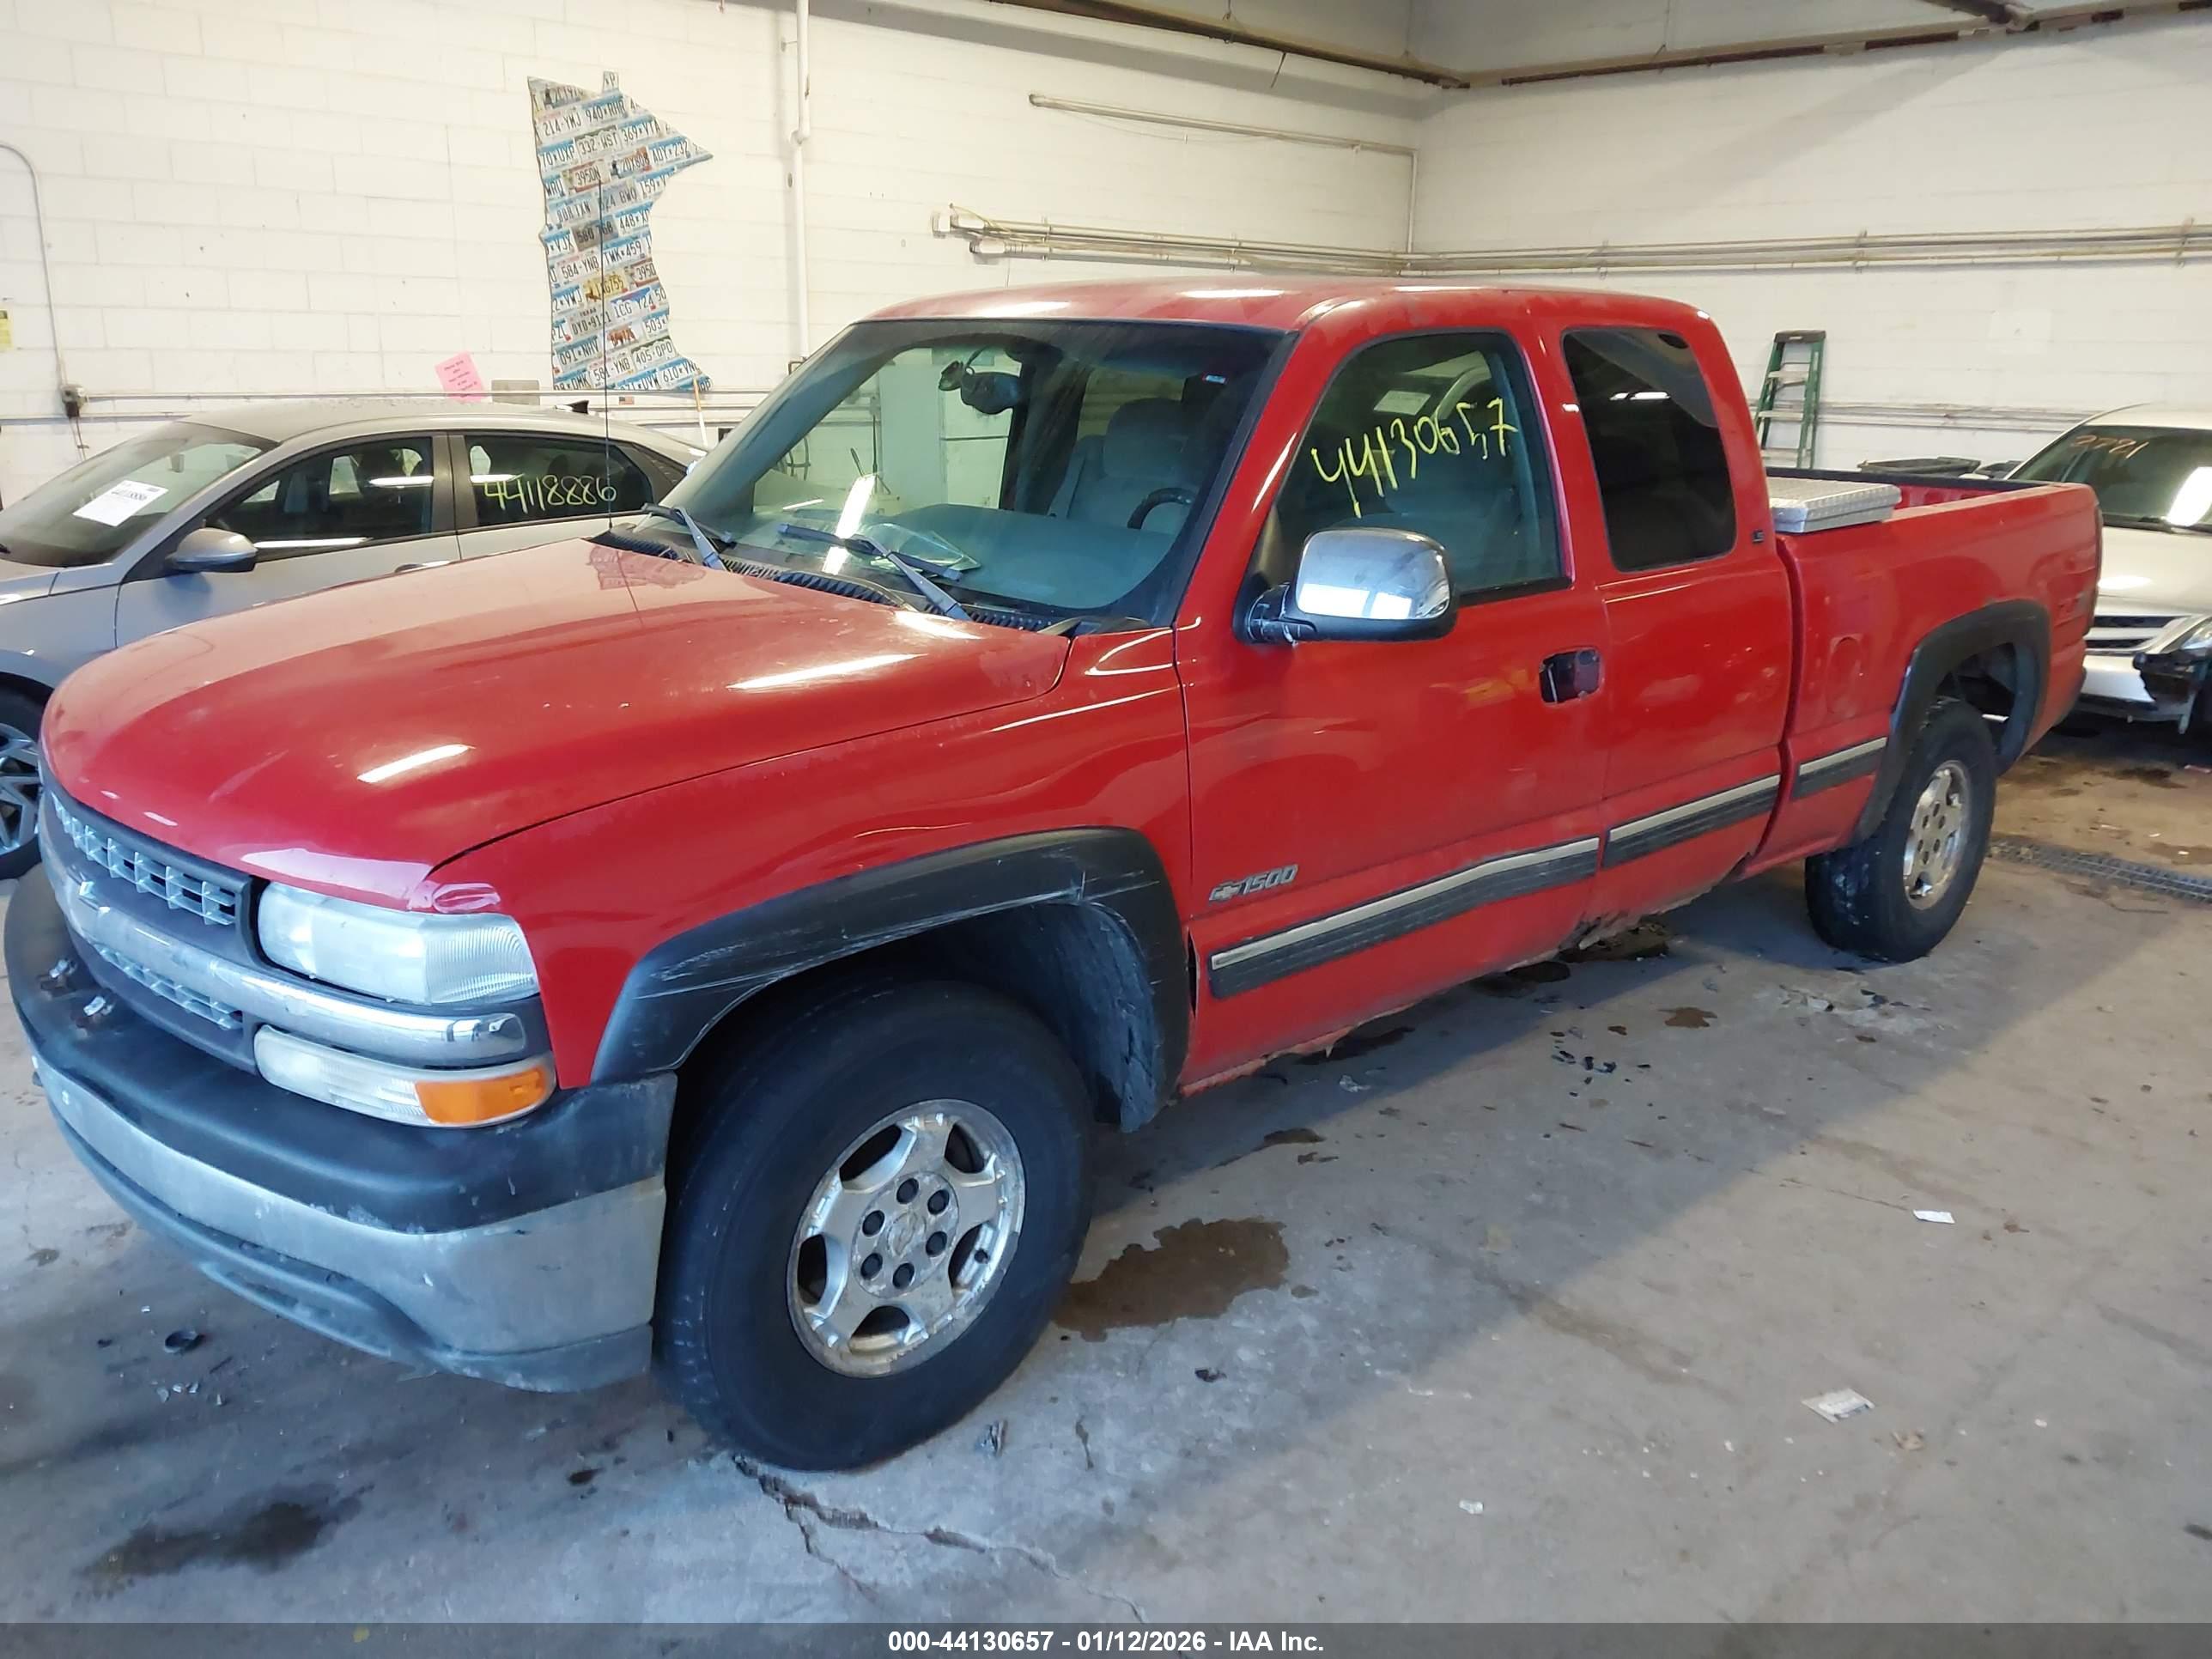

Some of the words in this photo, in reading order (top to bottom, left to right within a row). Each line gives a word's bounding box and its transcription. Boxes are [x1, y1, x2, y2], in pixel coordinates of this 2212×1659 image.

[1311, 397, 1519, 518] 44130657
[484, 473, 617, 514] 44118886
[1242, 864, 1298, 895] 1500
